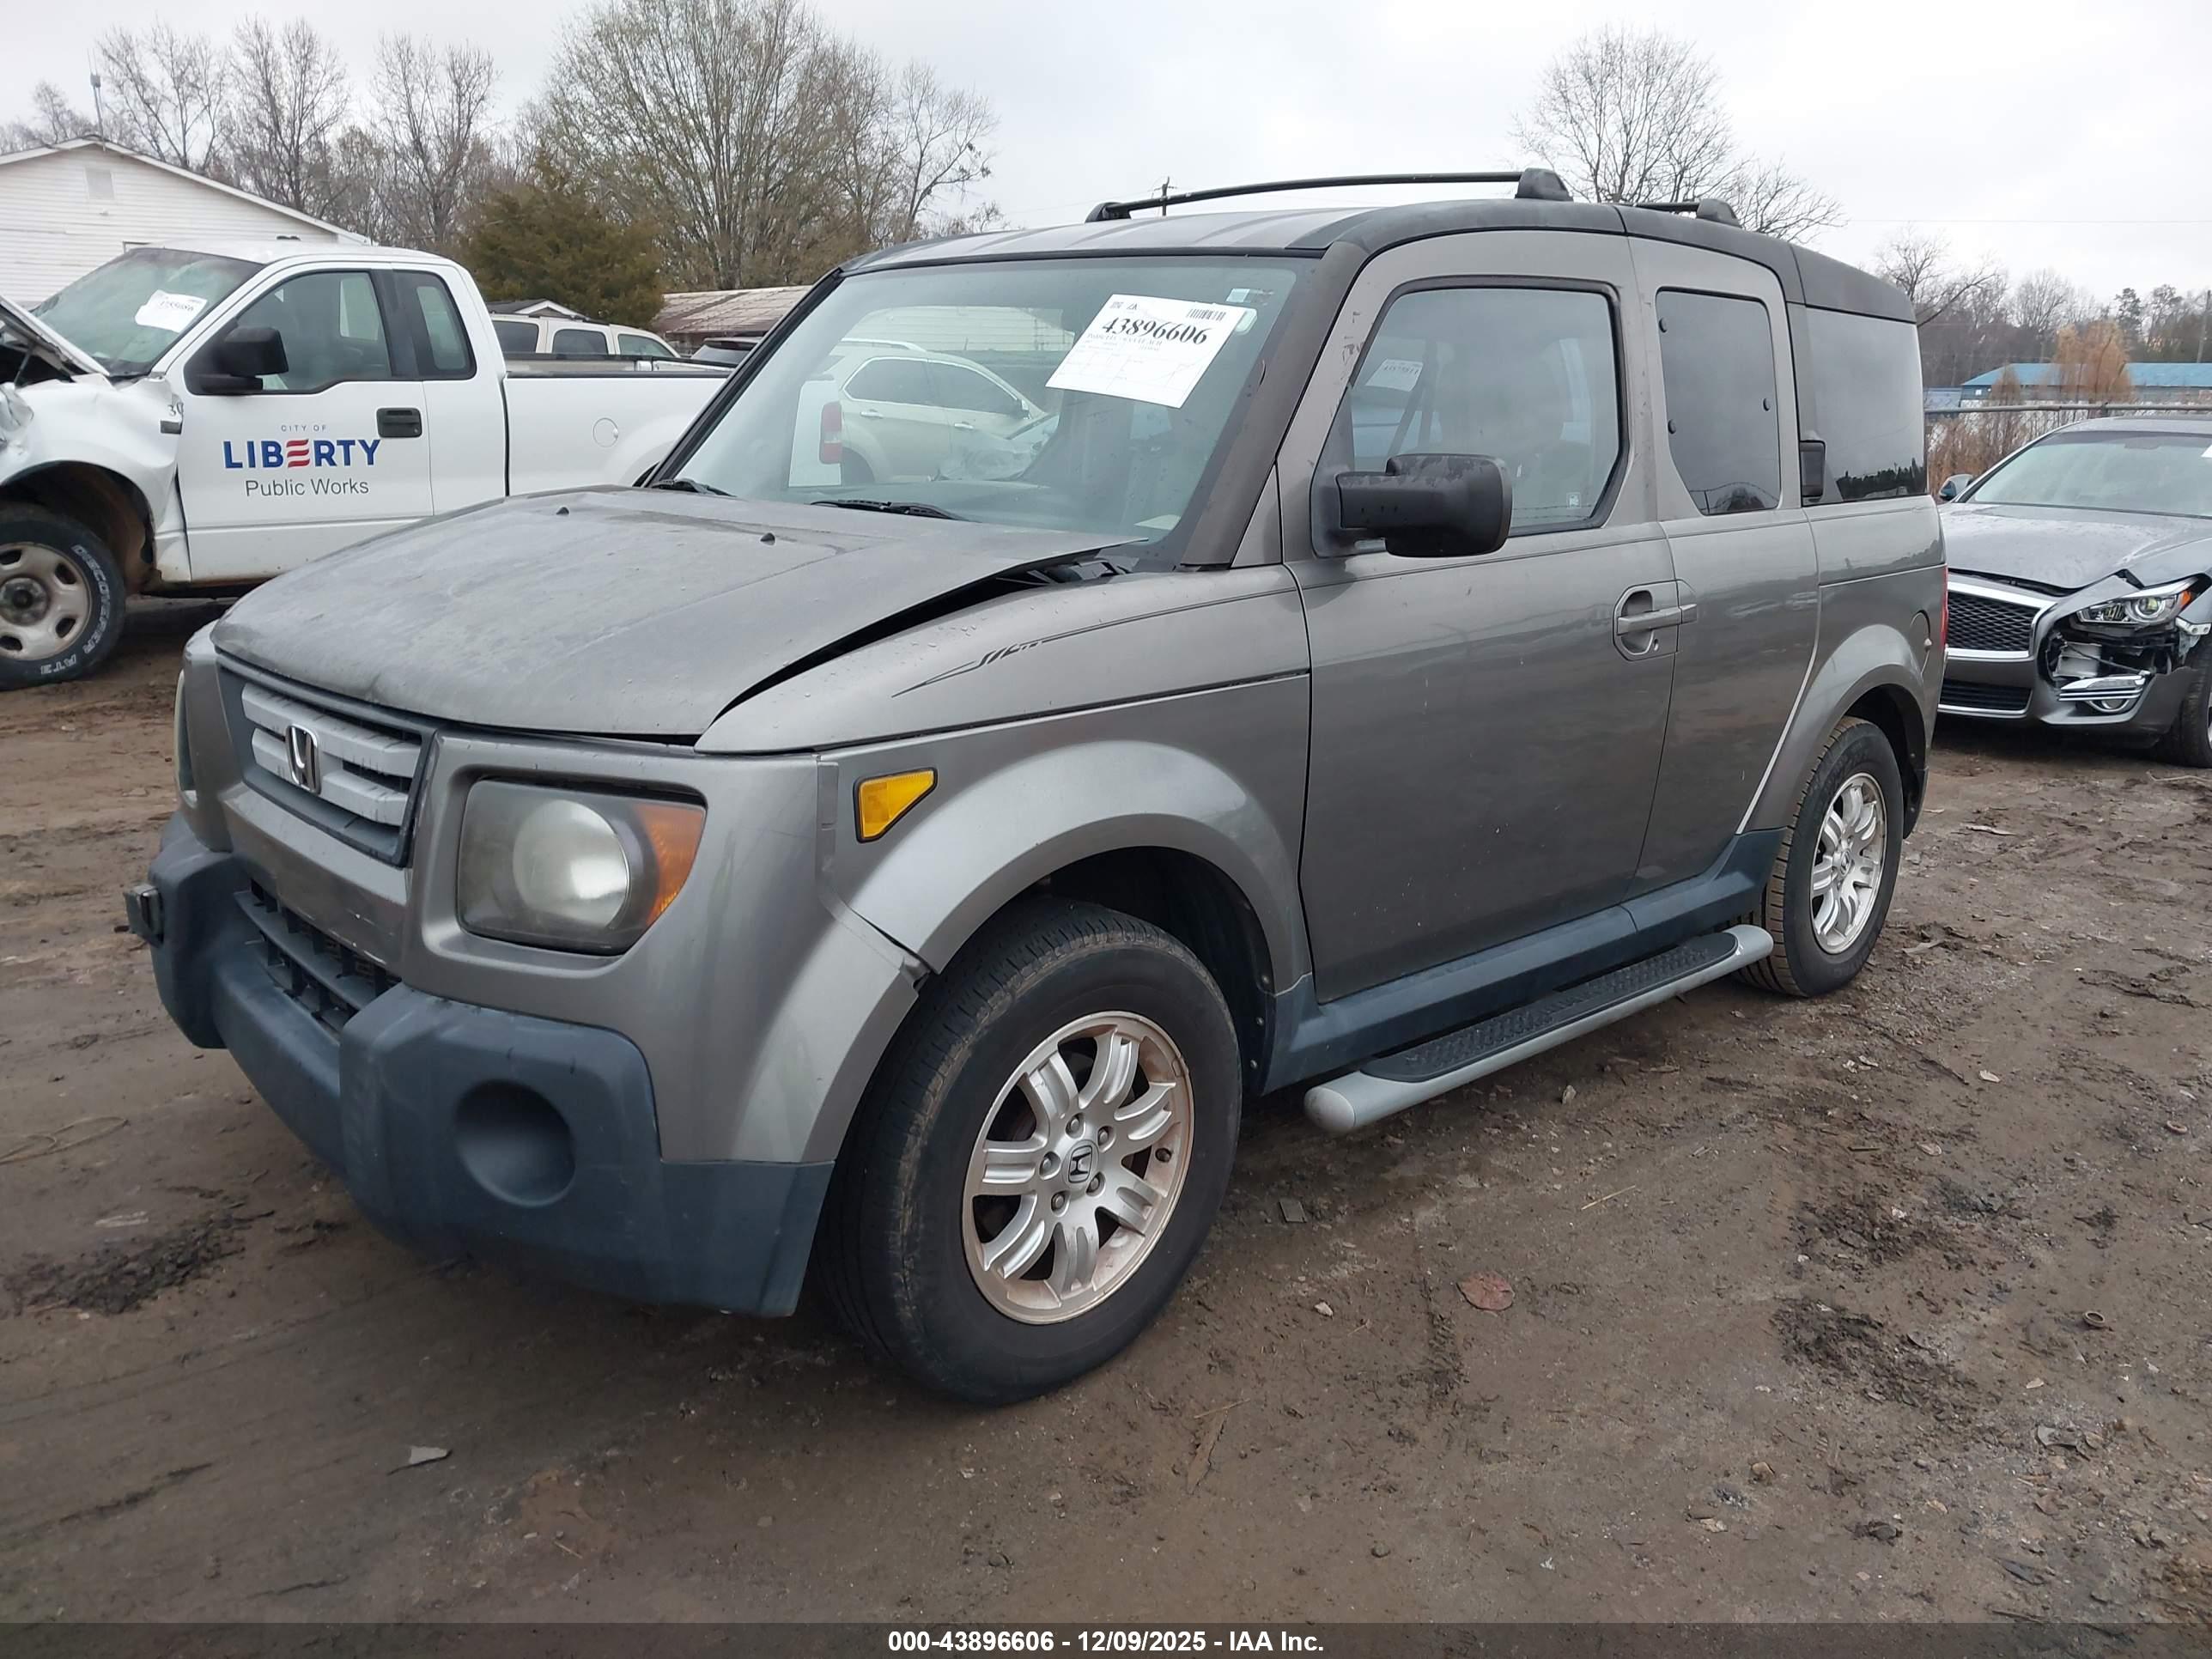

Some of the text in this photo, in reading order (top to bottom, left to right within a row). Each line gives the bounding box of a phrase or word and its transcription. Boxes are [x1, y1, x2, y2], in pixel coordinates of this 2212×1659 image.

[1102, 317, 1213, 344] 43896606
[223, 439, 380, 469] LIBERTY
[245, 477, 369, 496] Public Works
[73, 545, 110, 654] DISCOVERER
